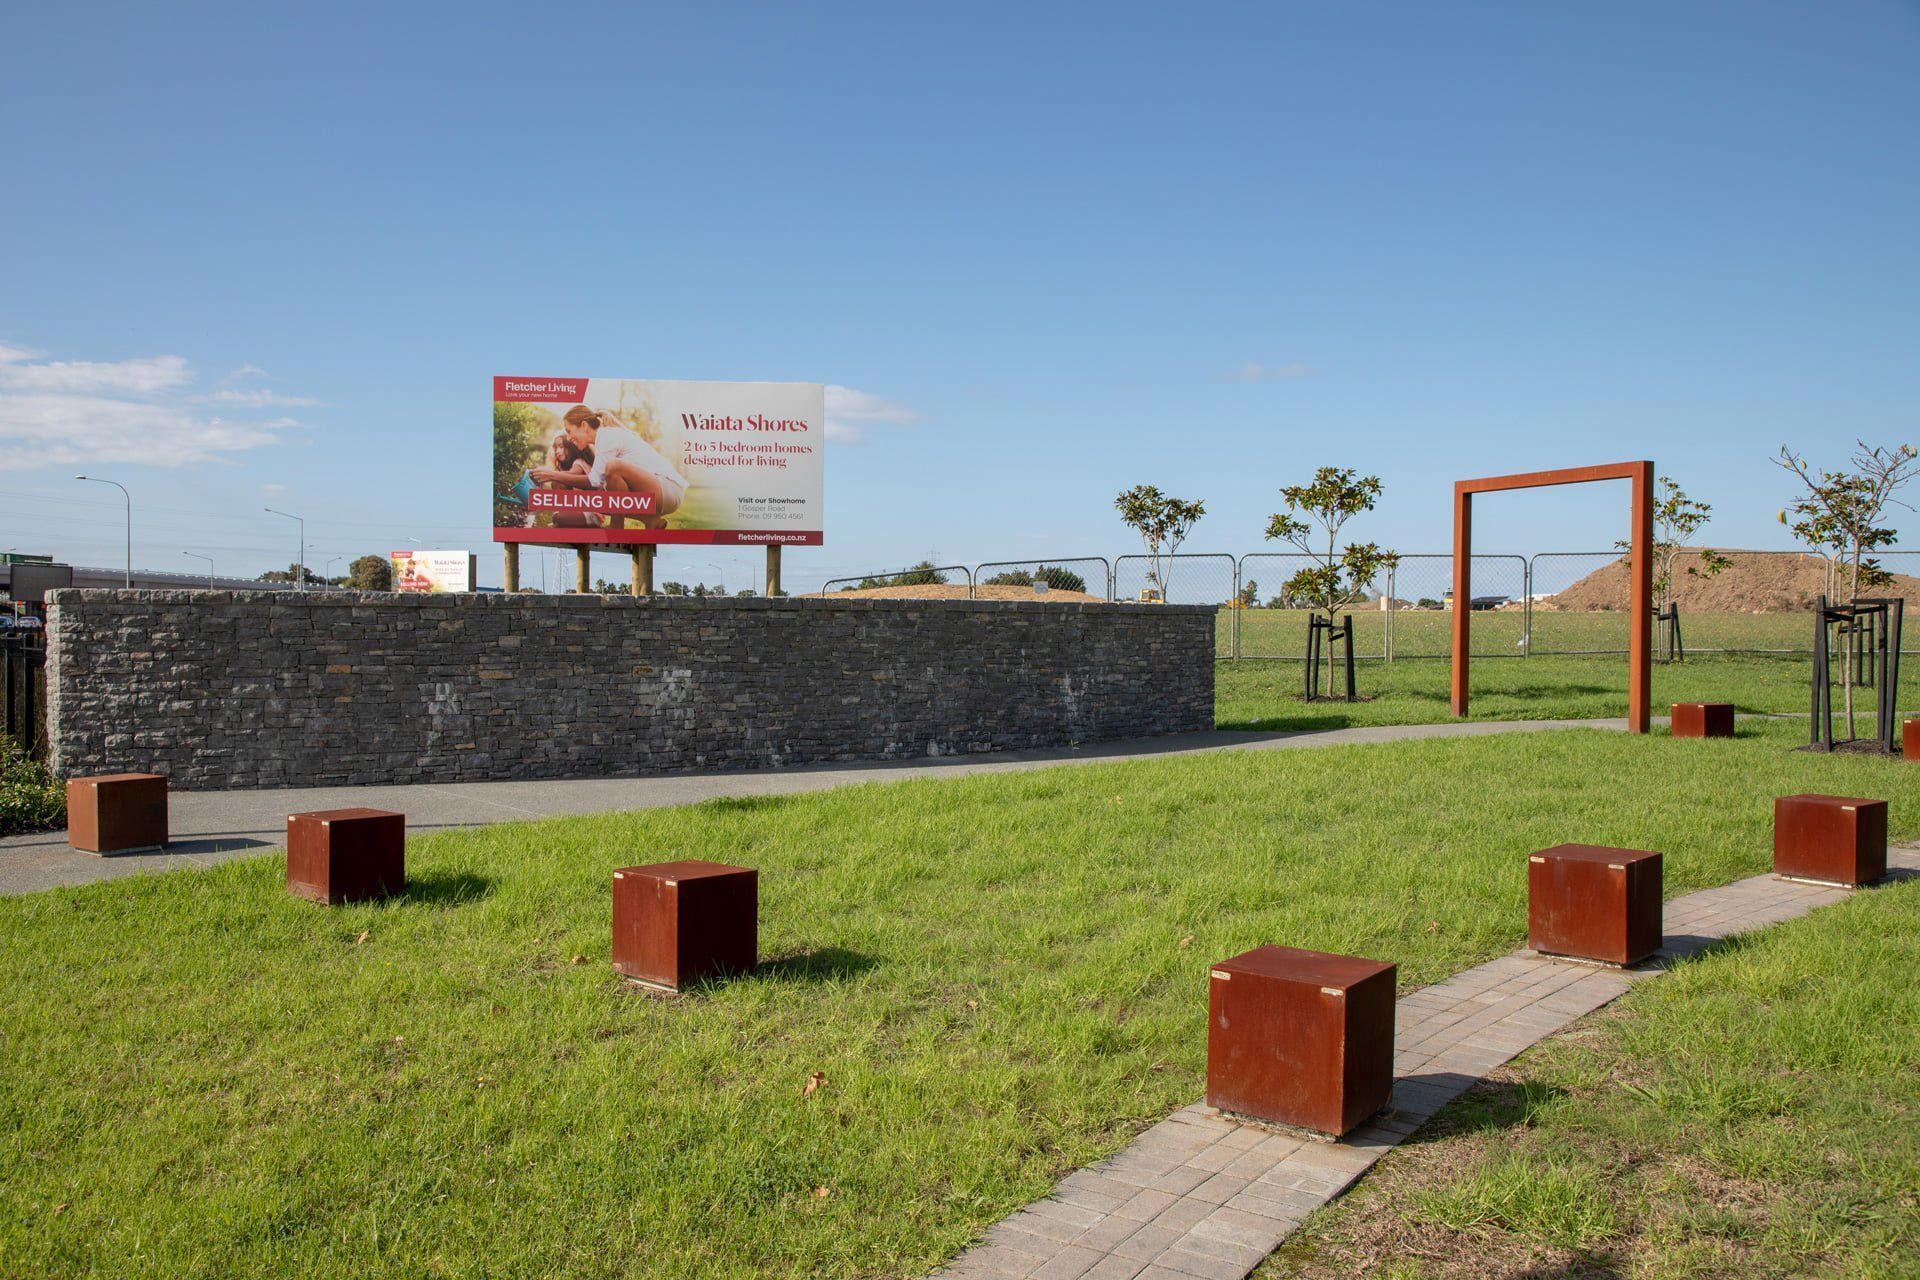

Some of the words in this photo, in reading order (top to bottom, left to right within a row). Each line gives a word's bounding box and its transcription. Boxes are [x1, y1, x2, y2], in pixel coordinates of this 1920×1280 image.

[505, 381, 546, 392] Fletcher
[548, 383, 577, 394] Living
[681, 413, 743, 431] Waiata
[746, 414, 808, 432] Shores
[684, 441, 691, 452] 2
[694, 442, 707, 452] to
[709, 441, 717, 452] 5
[719, 441, 772, 453] bedroom
[774, 442, 813, 454] homes
[683, 453, 735, 467] designed
[737, 455, 754, 466] for
[756, 455, 787, 468] living
[532, 493, 603, 508] SELLING
[608, 496, 651, 510] NOW
[768, 497, 806, 505] Showhome
[737, 533, 807, 542] fletcherliving.co.nz
